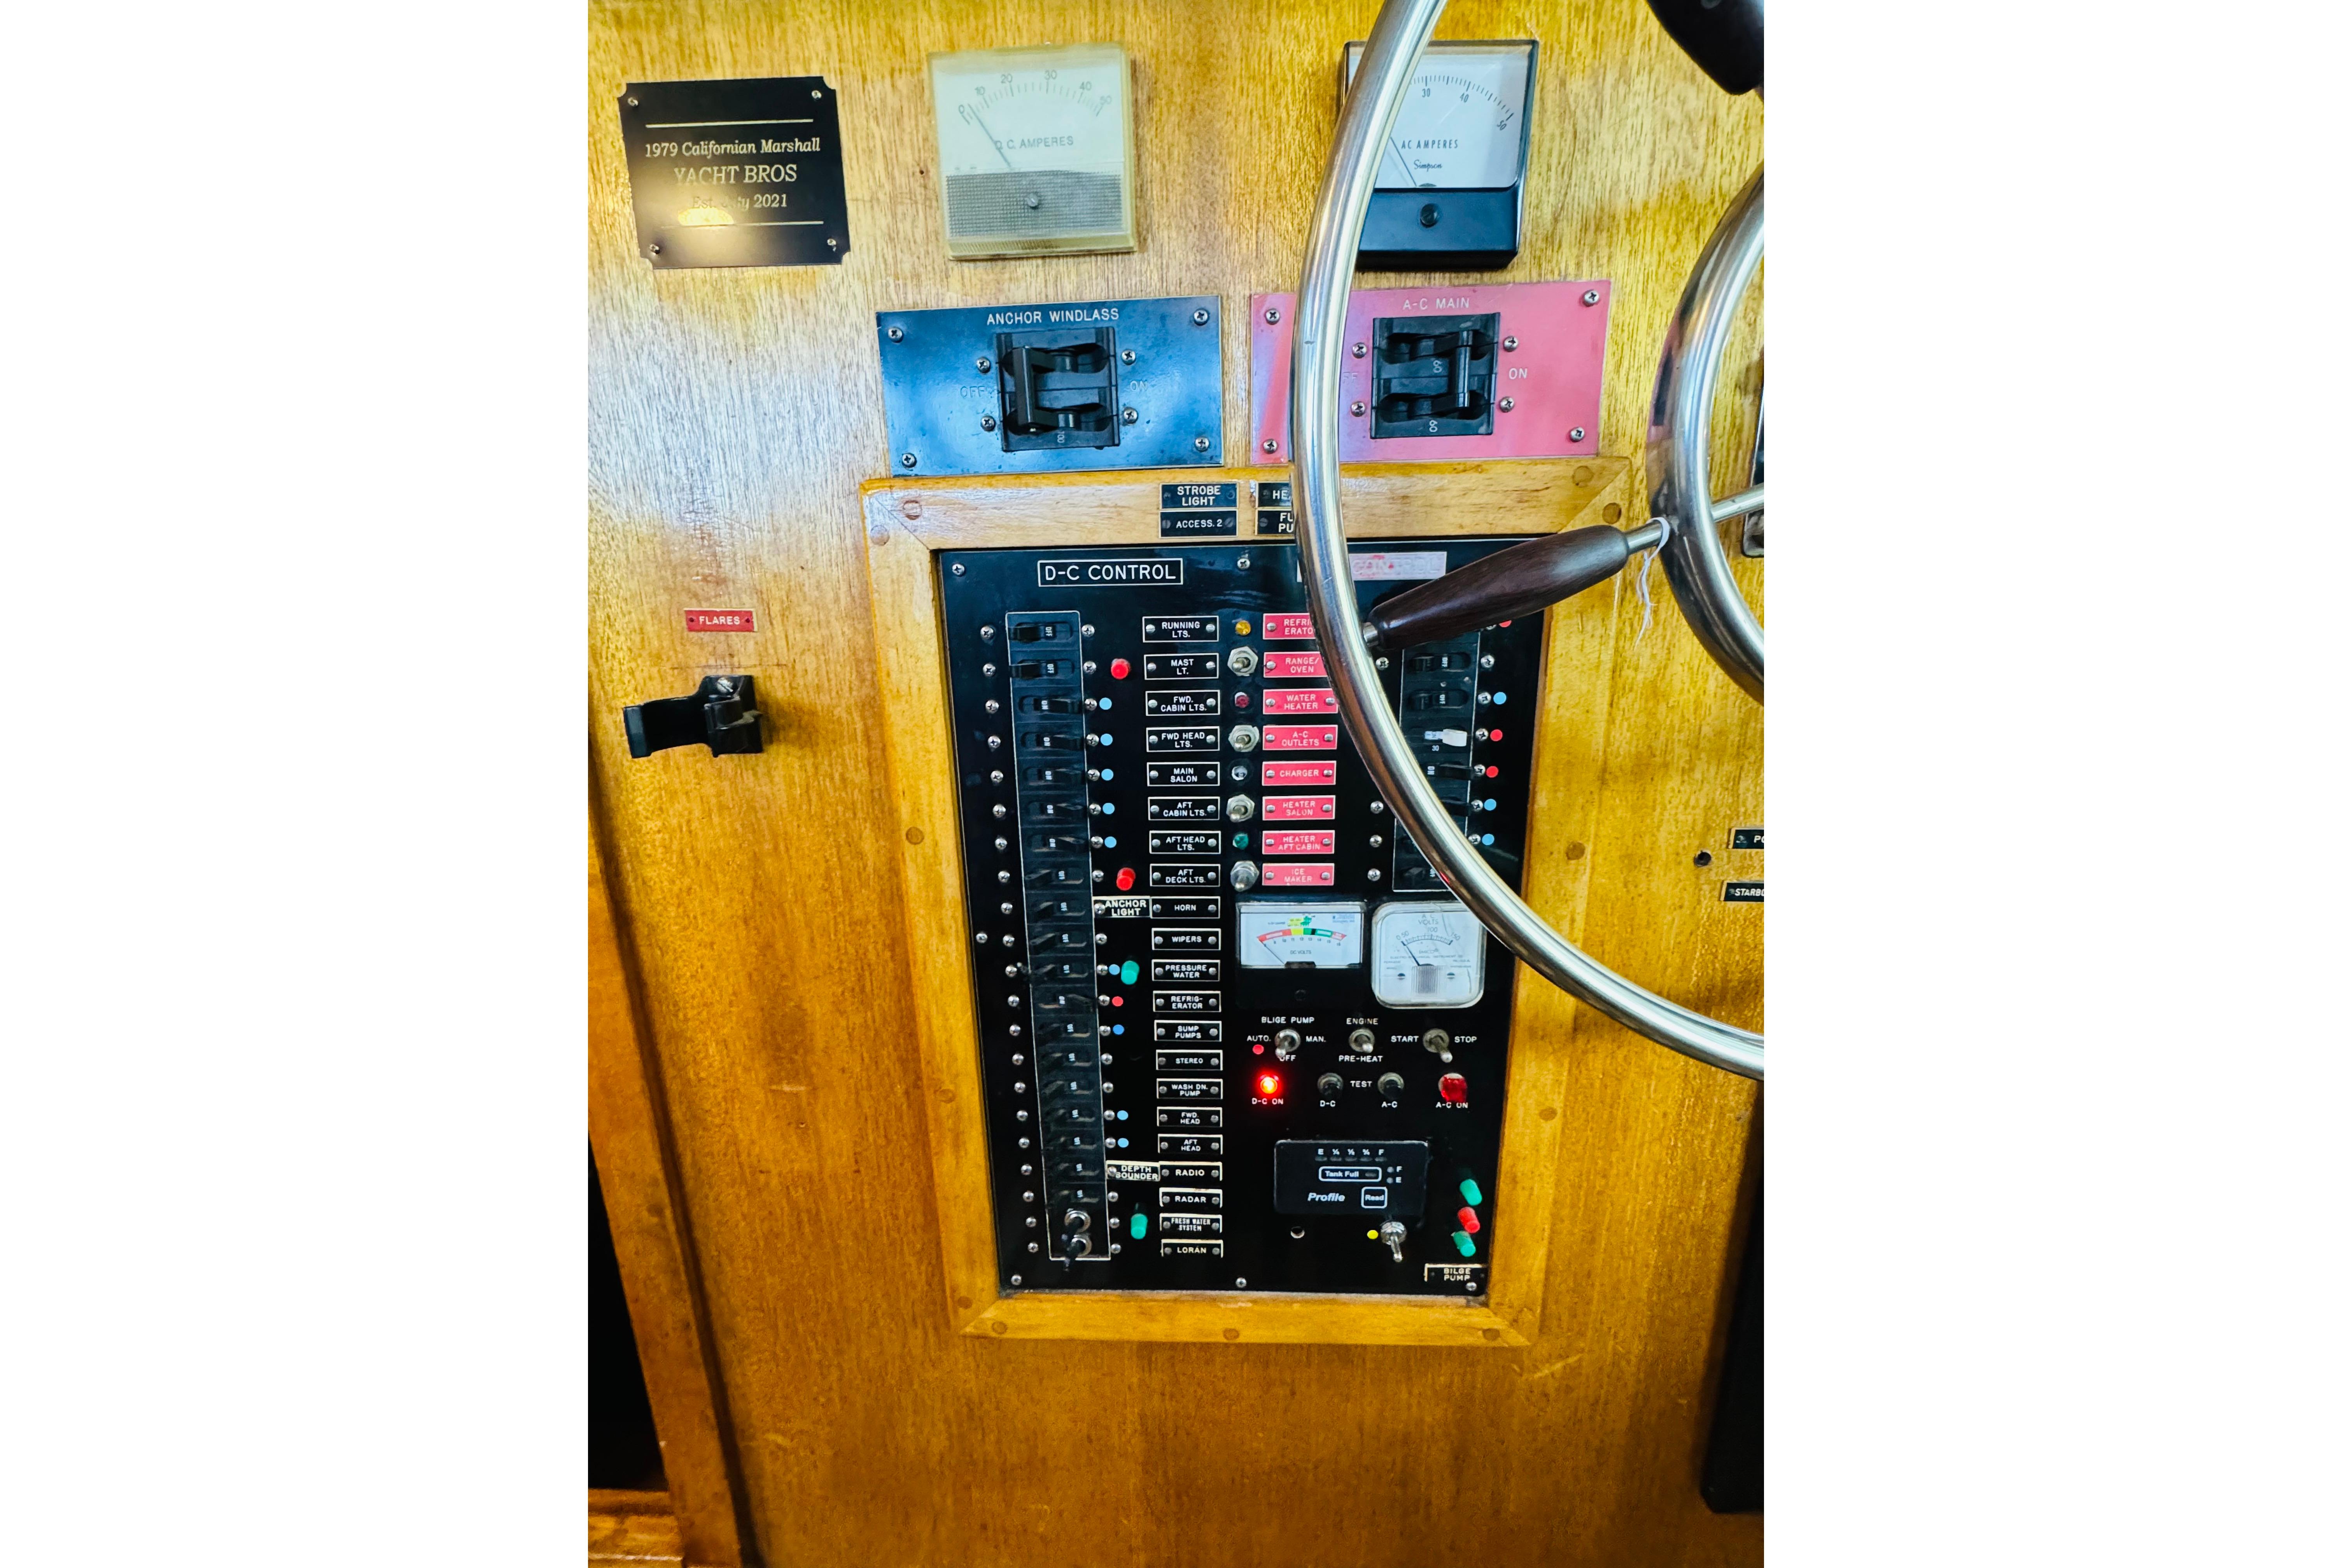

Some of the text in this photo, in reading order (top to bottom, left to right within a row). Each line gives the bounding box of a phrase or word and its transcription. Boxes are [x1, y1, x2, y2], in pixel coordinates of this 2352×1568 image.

[1001, 74, 1013, 83] 20
[1045, 70, 1057, 80] 30
[974, 86, 985, 95] 10
[1080, 81, 1092, 91] 40
[1422, 88, 1430, 97] 30
[1460, 93, 1469, 103] 40
[959, 104, 964, 114] 0
[1496, 120, 1507, 131] 50
[1020, 135, 1073, 148] AMPERES
[1401, 139, 1458, 149] AC AMPERES
[645, 138, 820, 159] 1979 Californian Marshall
[1413, 159, 1443, 172] Simpson
[674, 164, 797, 185] YACHT BROS
[753, 194, 787, 208] 2021
[1403, 298, 1470, 311] A-C MAIN
[987, 308, 1119, 326] ANCHOR WINDLASS
[1508, 368, 1528, 380] ON
[1130, 380, 1148, 392] ON
[960, 386, 985, 398] OFF
[1177, 485, 1221, 495] STROBE
[1273, 490, 1291, 499] HE
[1182, 497, 1215, 506] LIGHT
[1278, 523, 1293, 533] PU
[1352, 558, 1440, 574] CONTROL
[1045, 564, 1176, 581] D-C CONTROL
[699, 616, 740, 625] FLARES
[1162, 621, 1200, 630] RUNNING
[1041, 700, 1048, 710] ON
[1160, 703, 1207, 712] CABIN LTS.
[1043, 737, 1050, 747] ON
[1282, 739, 1320, 747] OUTLETS
[1280, 769, 1319, 777] CHARGER
[1427, 766, 1435, 775] ON
[1105, 900, 1146, 908] ANCHOR
[1111, 908, 1141, 916] LIGHT
[1115, 1172, 1158, 1180] SOUNDER
[1307, 1192, 1346, 1202] Profile
